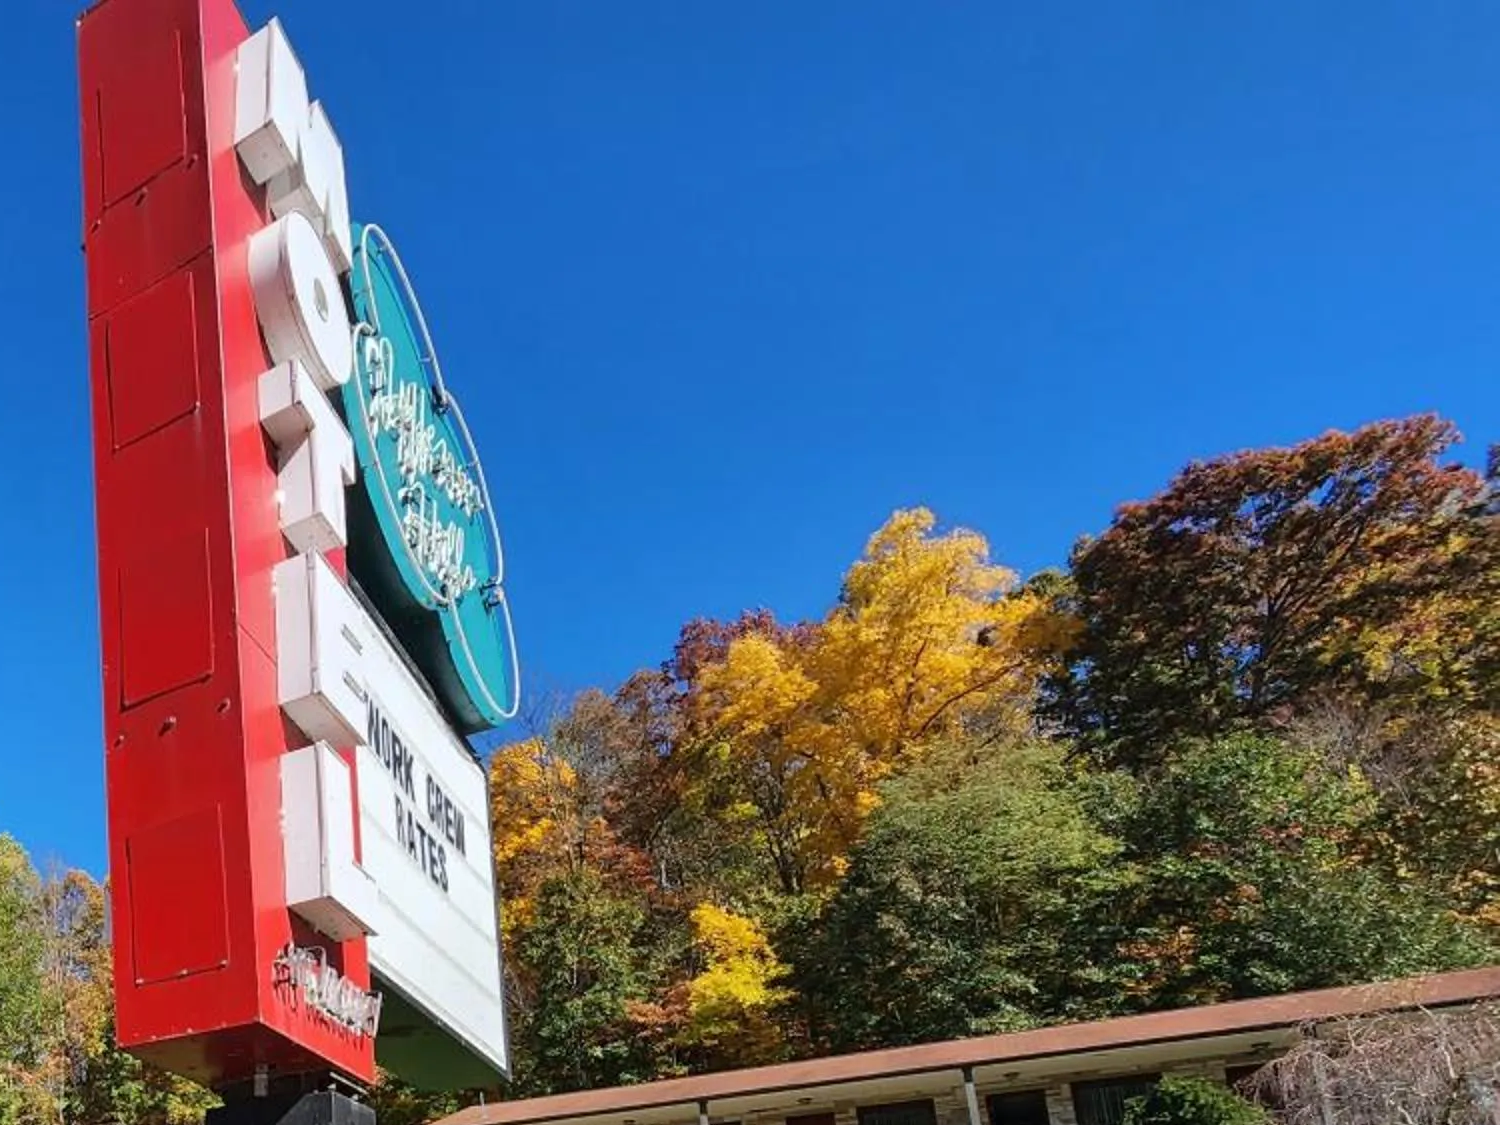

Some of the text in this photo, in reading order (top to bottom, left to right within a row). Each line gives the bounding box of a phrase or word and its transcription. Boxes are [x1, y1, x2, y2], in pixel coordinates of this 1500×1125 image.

[234, 15, 378, 936] MOTEL
[395, 792, 448, 893] RATES
[426, 774, 466, 858] CREW
